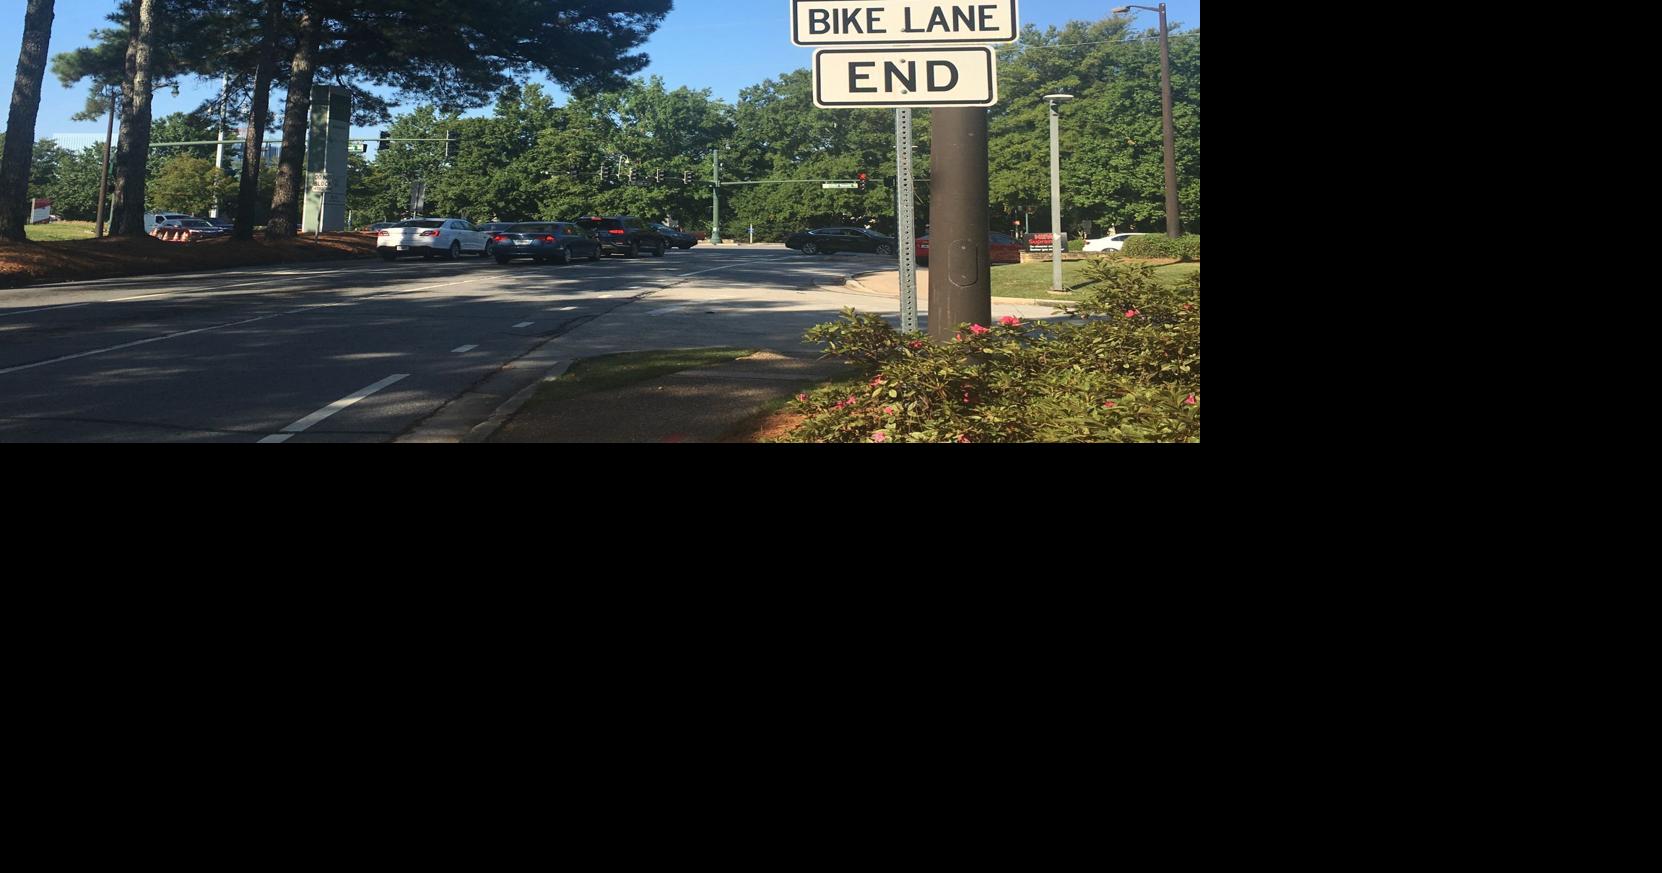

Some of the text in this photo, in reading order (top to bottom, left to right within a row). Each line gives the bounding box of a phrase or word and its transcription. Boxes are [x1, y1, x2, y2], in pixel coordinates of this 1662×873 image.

[808, 4, 1000, 35] BIKE LANE
[849, 60, 959, 93] END
